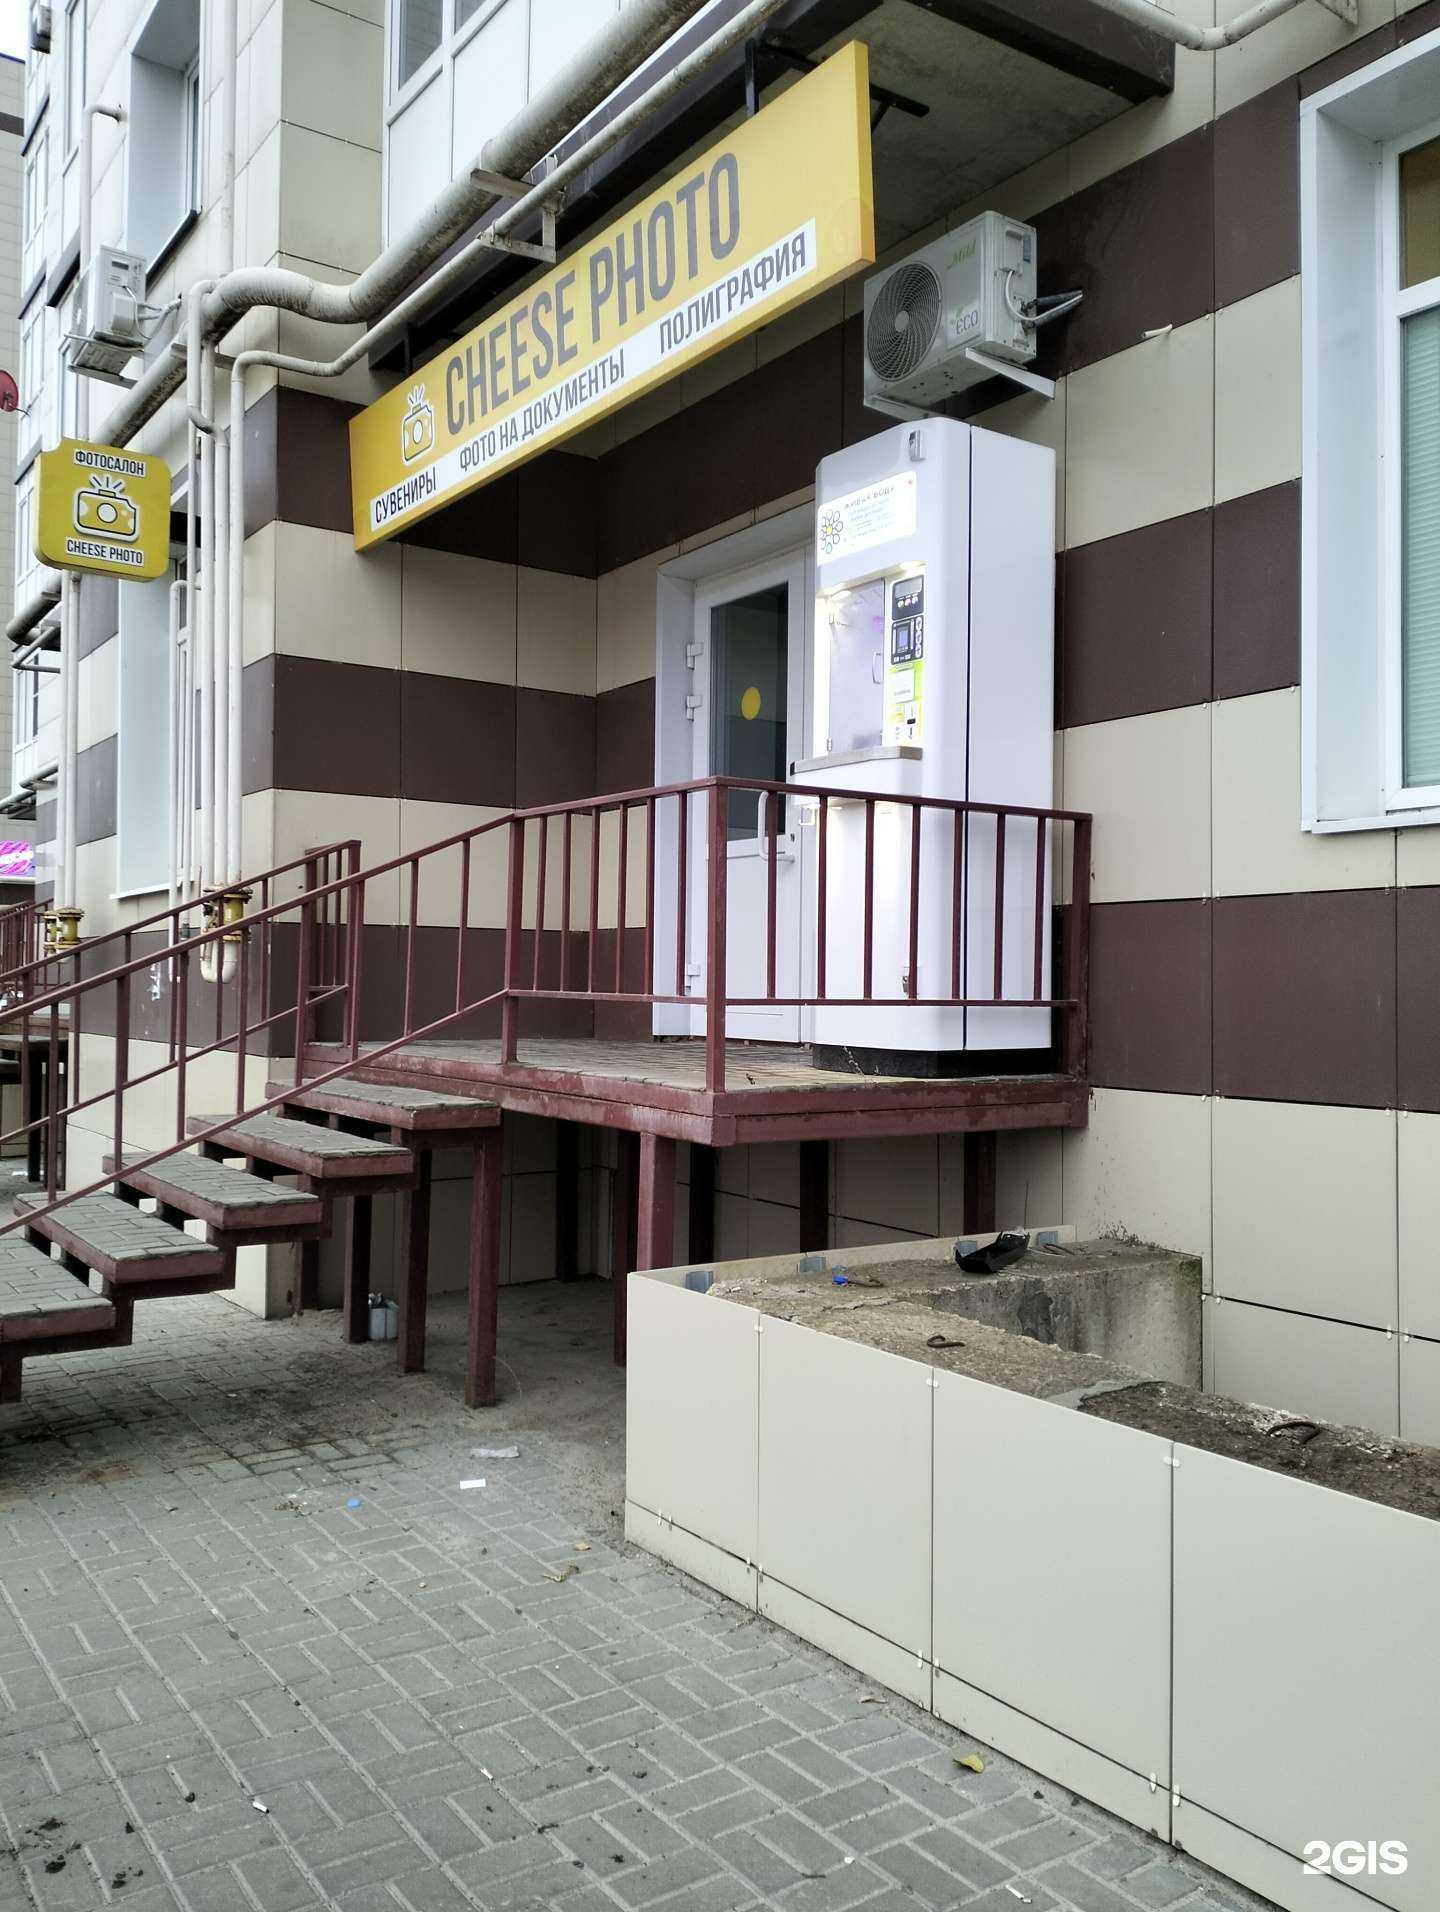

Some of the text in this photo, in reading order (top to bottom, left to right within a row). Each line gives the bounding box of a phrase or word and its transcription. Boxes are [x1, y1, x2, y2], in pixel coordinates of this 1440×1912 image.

[446, 152, 740, 436] CHEESE PHOTO
[375, 232, 806, 523] СУВЕНИРЫ ФОТО НА ДОКУМЕНТЫ ПОЛИГРАФИЯ
[75, 450, 144, 476] ФОТОСАЛОН
[67, 539, 143, 564] CHEESE PHOTO
